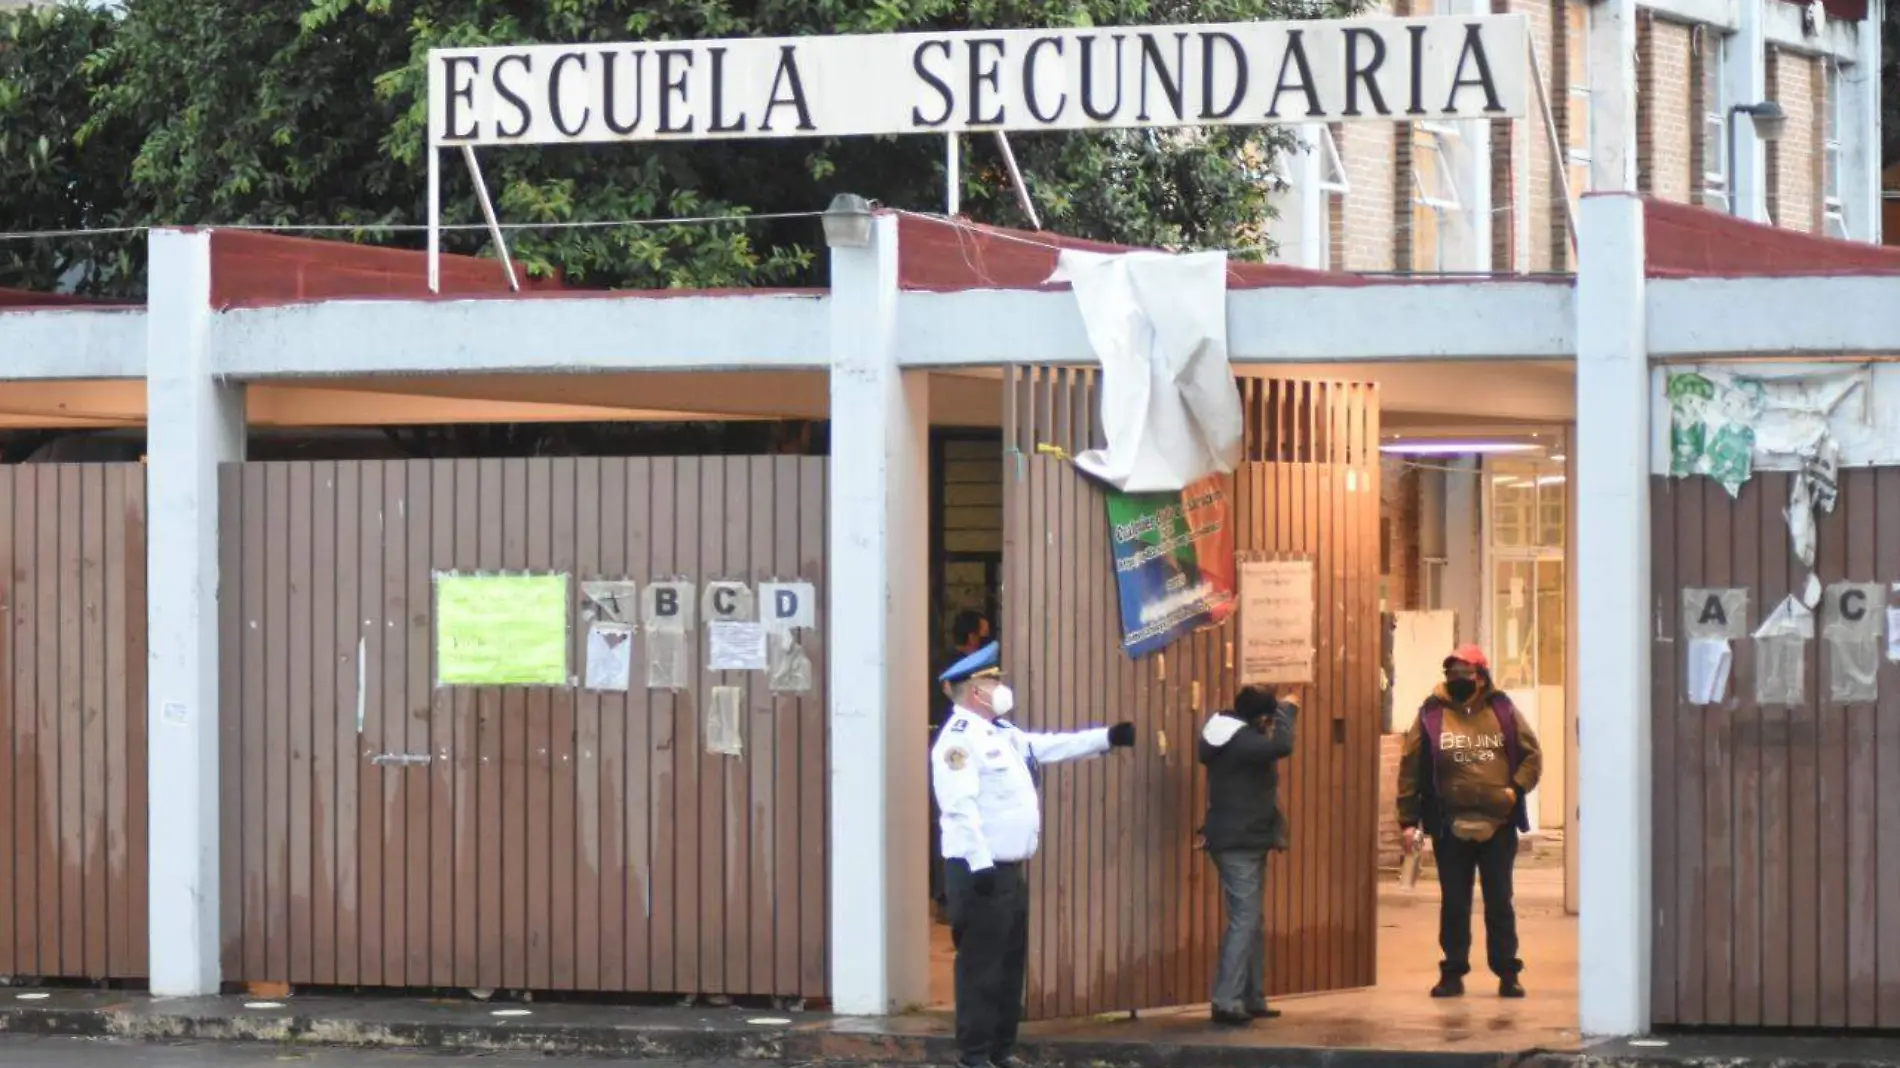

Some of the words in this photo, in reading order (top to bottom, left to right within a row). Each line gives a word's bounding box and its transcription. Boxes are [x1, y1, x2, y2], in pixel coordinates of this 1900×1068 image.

[441, 45, 817, 141] ESCUELA
[912, 22, 1507, 127] SECUNDARIA
[655, 587, 680, 616] B
[713, 587, 736, 615] C
[775, 589, 799, 619] D
[1697, 594, 1728, 625] A
[1839, 589, 1867, 621] C
